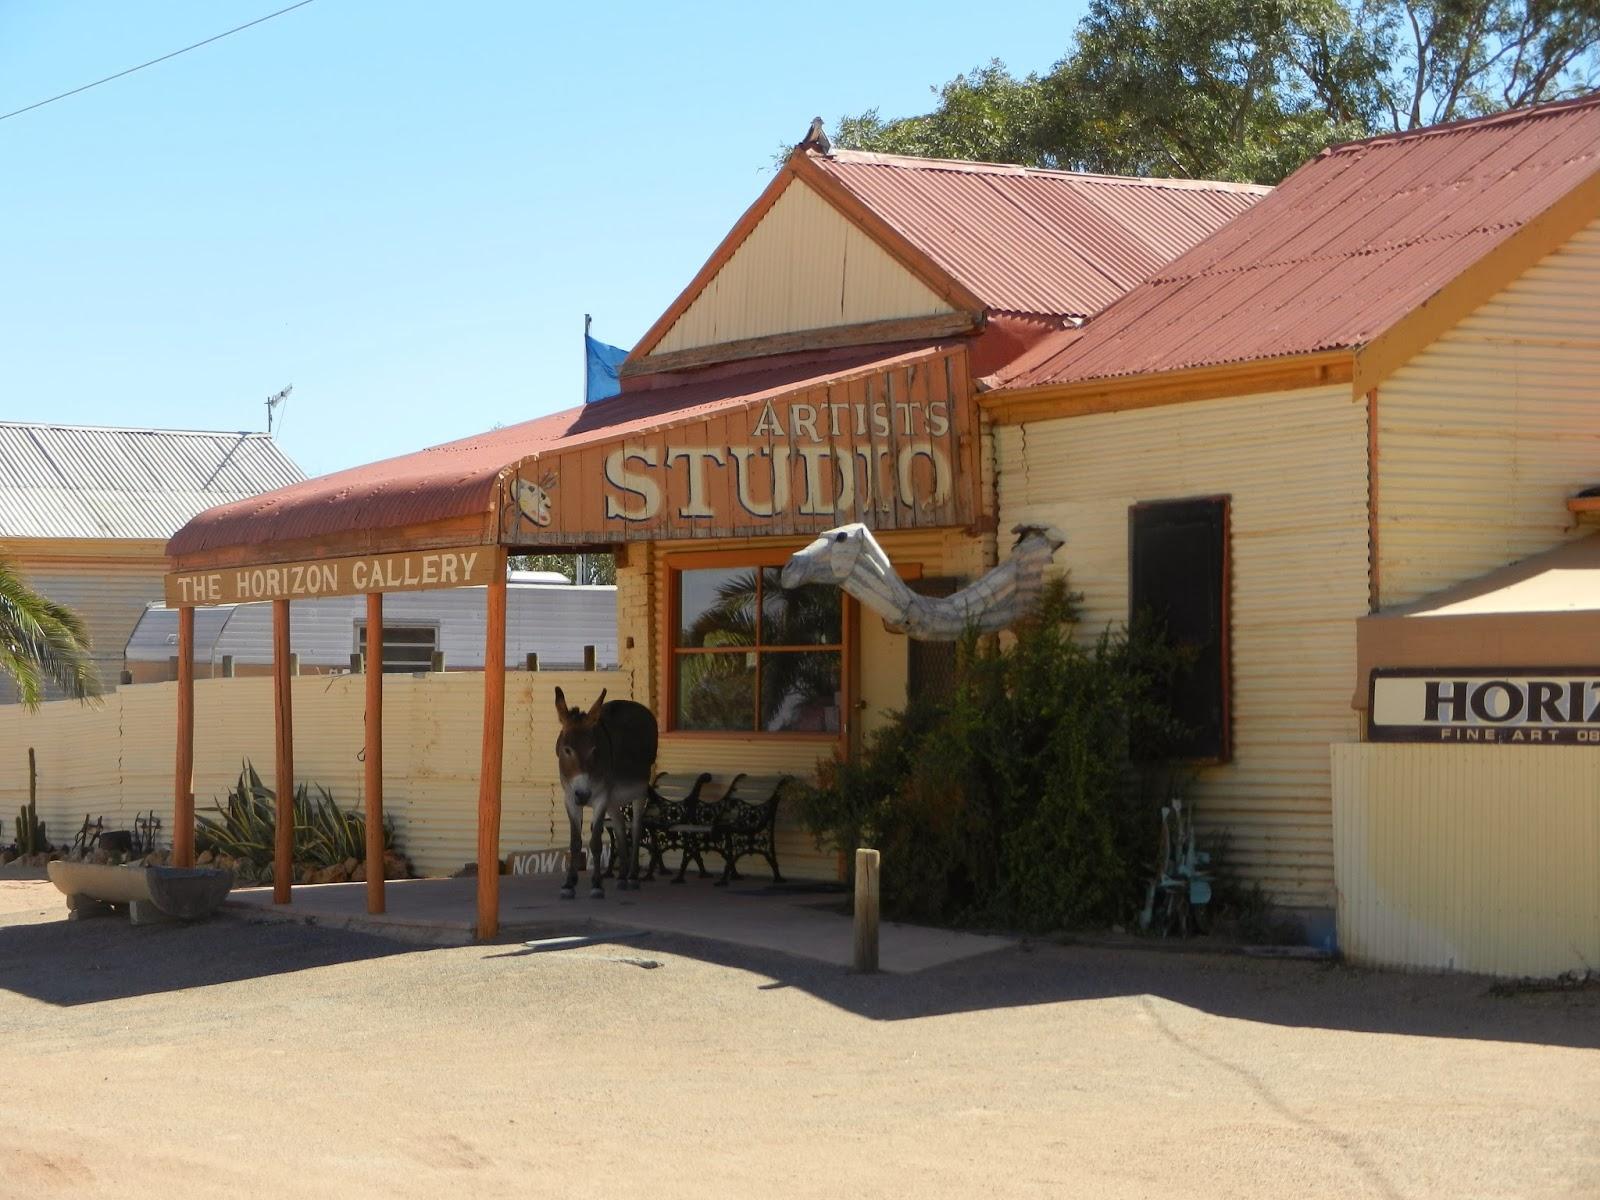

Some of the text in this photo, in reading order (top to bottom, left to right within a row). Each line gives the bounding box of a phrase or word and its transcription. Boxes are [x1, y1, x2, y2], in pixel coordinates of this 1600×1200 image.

[753, 400, 950, 443] ARTISTS
[604, 445, 952, 522] STUDIO
[177, 552, 478, 602] THE HORIZON GALLERY
[1441, 728, 1496, 741] FINE
[1511, 729, 1560, 742] ART
[512, 851, 560, 876] NOW
